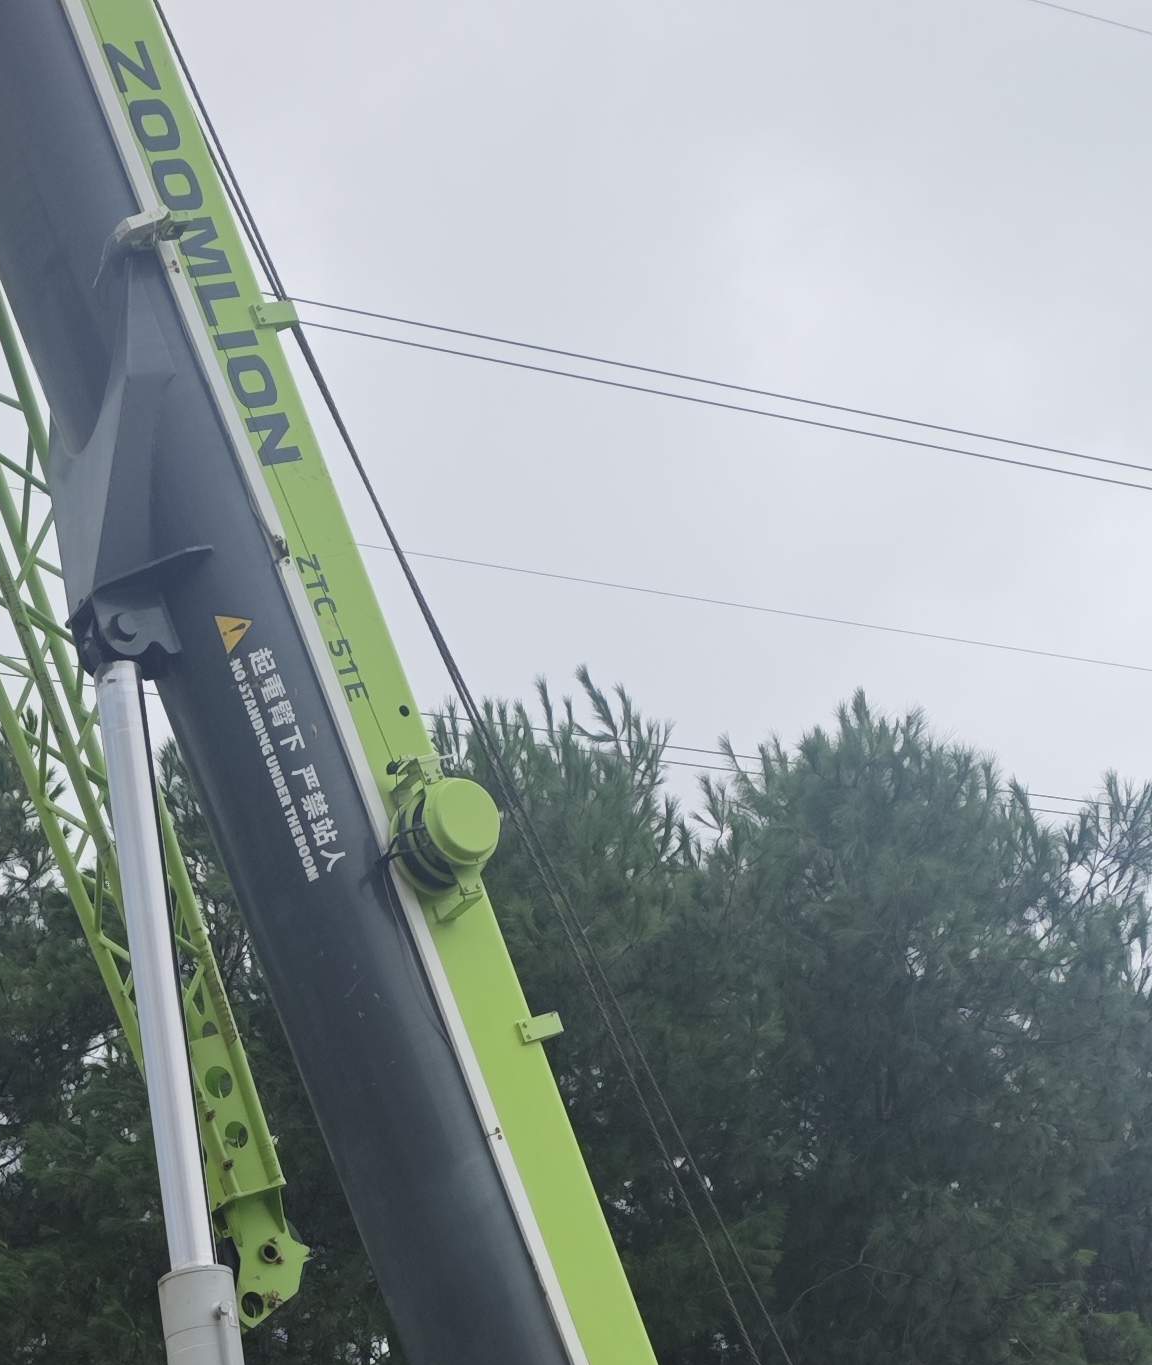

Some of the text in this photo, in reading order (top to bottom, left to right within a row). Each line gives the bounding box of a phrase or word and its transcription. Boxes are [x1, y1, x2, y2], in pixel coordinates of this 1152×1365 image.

[102, 40, 303, 467] ZOOMLION
[296, 553, 337, 617] ZTC
[229, 657, 320, 882] NO STANDING UNDER THE BOOM
[248, 647, 346, 872] 起重臂下 严禁站人
